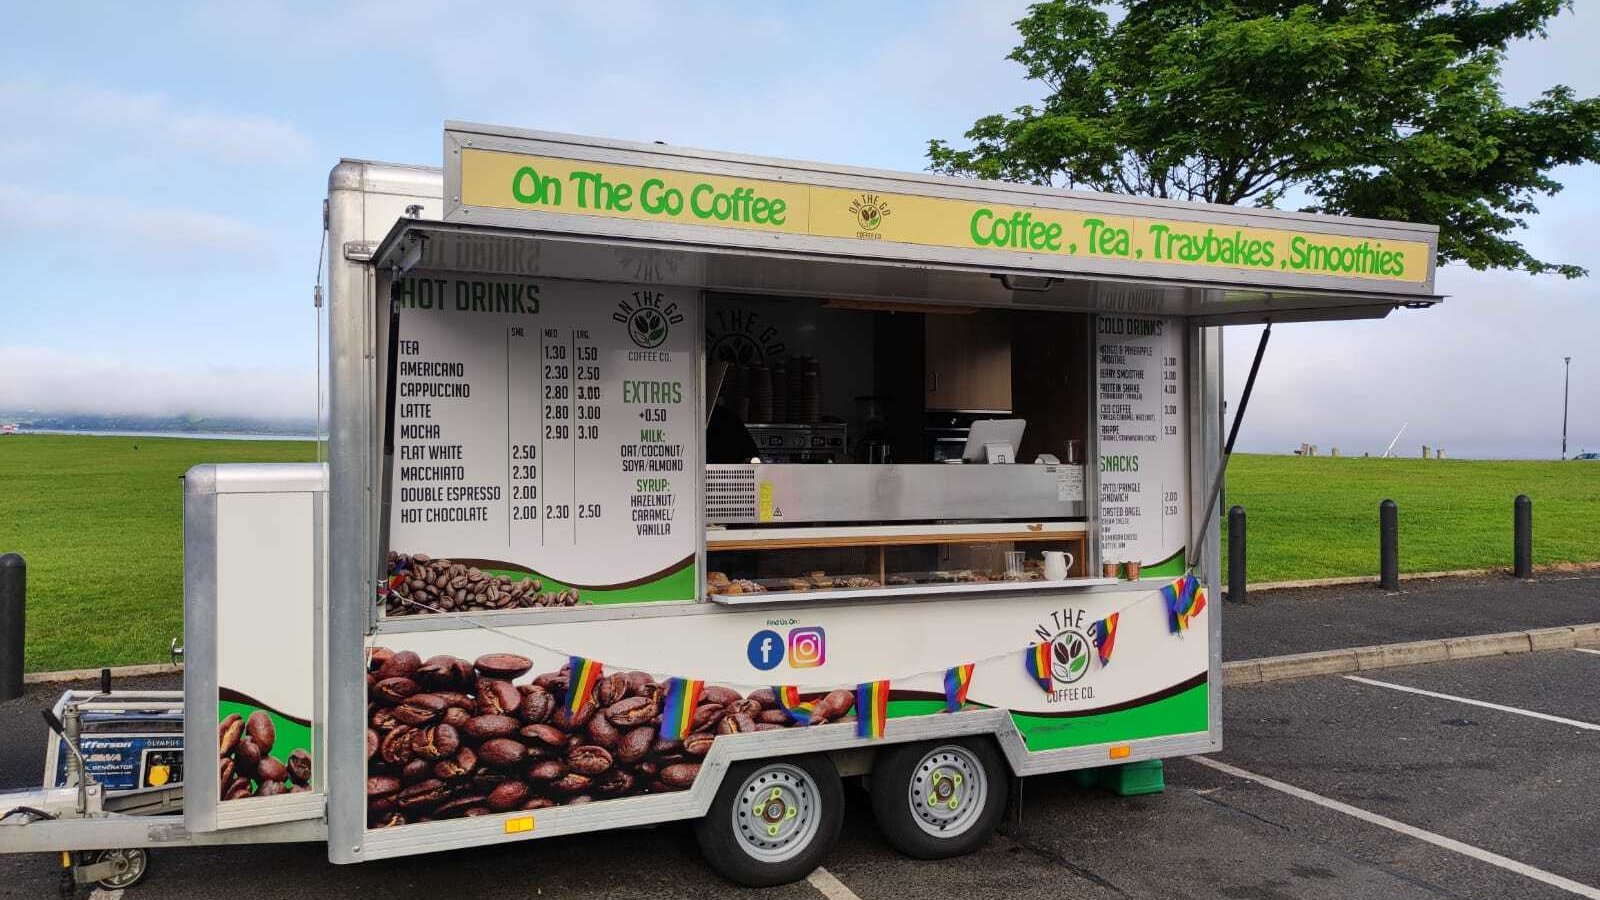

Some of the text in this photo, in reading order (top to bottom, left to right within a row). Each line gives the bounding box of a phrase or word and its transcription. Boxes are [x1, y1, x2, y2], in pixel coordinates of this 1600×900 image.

[511, 165, 787, 226] On The Go Coffee
[849, 194, 891, 216] ON THE GO
[400, 277, 541, 315] HOT DRINKS
[612, 290, 684, 325] ON THE GO
[1127, 318, 1164, 337] DRINKS
[400, 341, 598, 361] TEA 1.30 1.50
[628, 351, 657, 362] COFFEE
[400, 362, 600, 381] AMERICANO 2.30 2.50
[400, 382, 601, 401] CAPPUCCINO 2.80 3.00
[622, 380, 682, 405] EXTRAS
[400, 403, 601, 420] LATTE 2.80 3.00
[638, 408, 667, 423] +0.50
[400, 424, 599, 440] MOCHA 2.90 3.10
[639, 429, 666, 443] MILK:
[400, 444, 536, 461] FLAT WHITE 2.50
[620, 444, 685, 458] OAT/COCONUT/
[621, 458, 684, 472] SOYA/ALMOND
[1099, 455, 1139, 472] SNACKS
[400, 465, 537, 481] MACCHIATO 2.30
[635, 478, 670, 493] SYRUP:
[400, 486, 537, 503] DOUBLE ESPRESSO 2.00
[630, 494, 676, 508] HAZELNUT/
[1164, 491, 1178, 502] 2.00
[400, 504, 602, 524] HOT CHOCOLATE 2.00 2.30 2.50
[631, 507, 675, 522] CARAMEL/
[1164, 505, 1178, 516] 2.50
[636, 523, 671, 536] VANILLA
[766, 619, 779, 627] Find
[1050, 607, 1086, 630] THE
[1081, 686, 1096, 700] CO.
